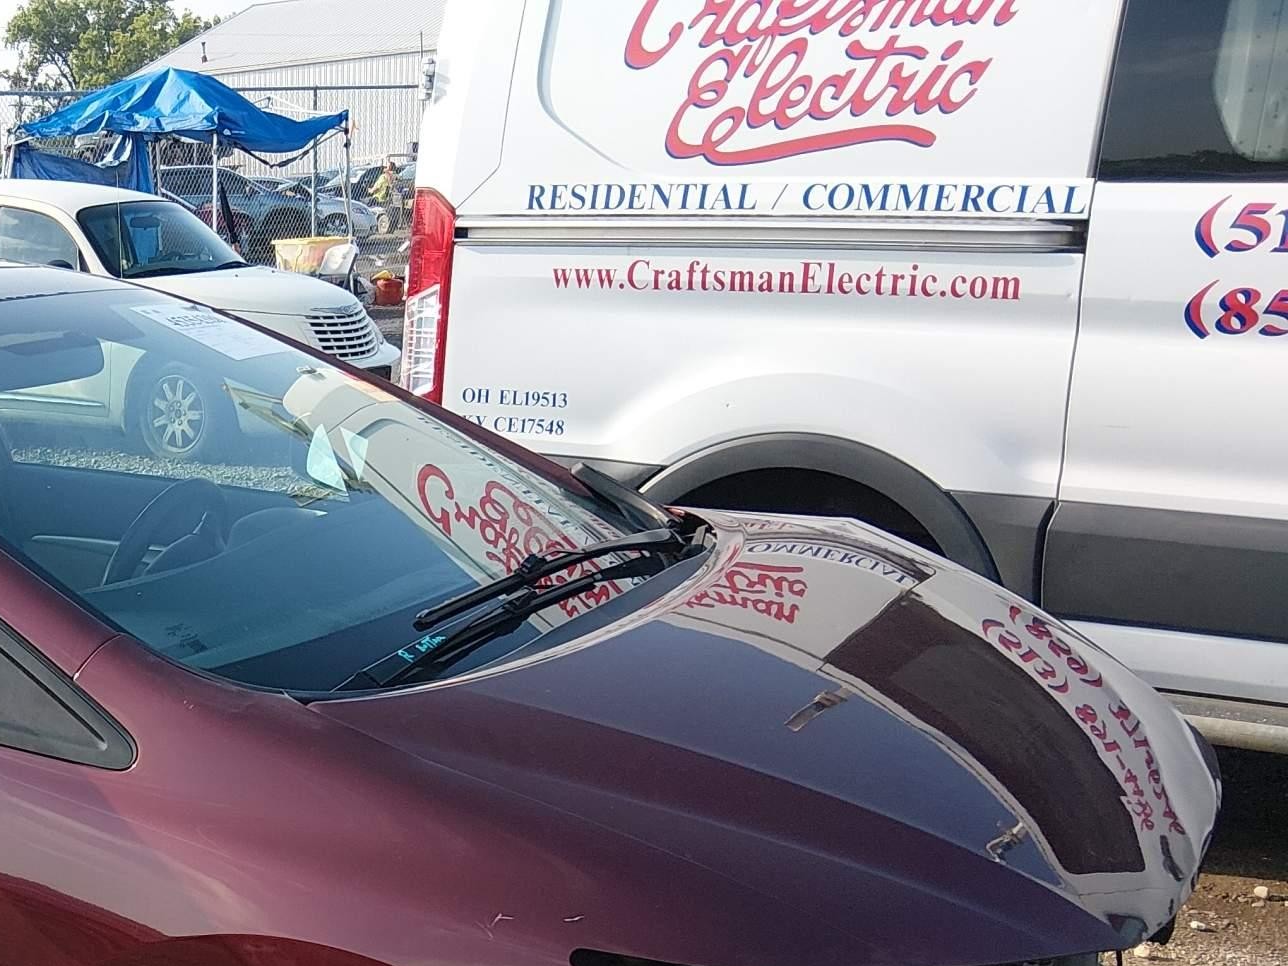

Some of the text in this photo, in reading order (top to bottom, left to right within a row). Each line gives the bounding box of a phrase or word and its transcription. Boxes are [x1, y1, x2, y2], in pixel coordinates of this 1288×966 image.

[665, 35, 993, 166] Electric
[527, 183, 1087, 214] RESIDENTIAL / COMMERCIAL
[553, 259, 1021, 301] www.CraftsmanElectric.com
[462, 387, 568, 408] OH EL19513
[493, 416, 565, 436] CE17548
